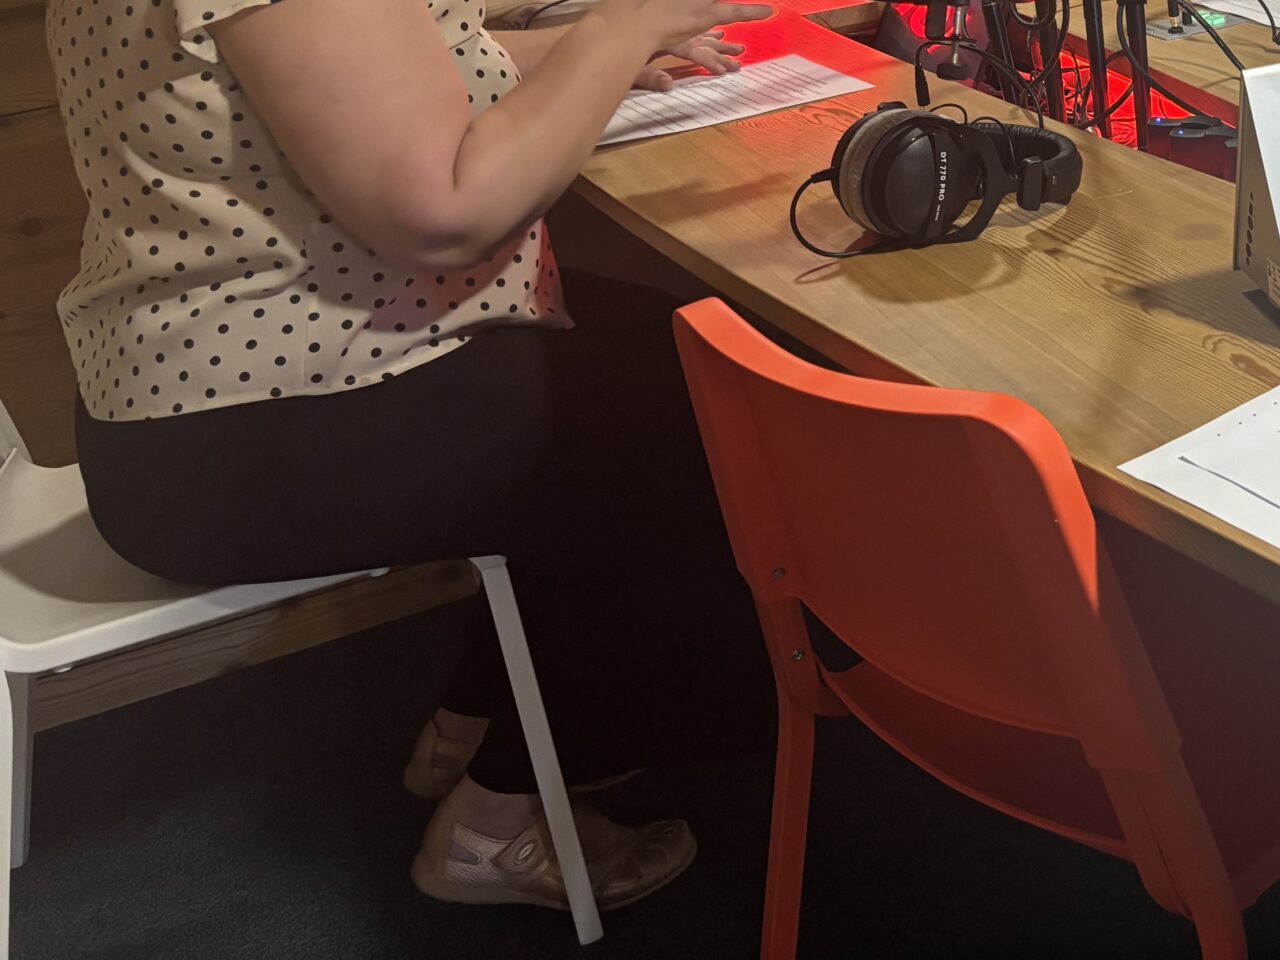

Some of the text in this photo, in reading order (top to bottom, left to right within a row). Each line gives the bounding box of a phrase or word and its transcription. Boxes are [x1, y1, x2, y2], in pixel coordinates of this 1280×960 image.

[940, 151, 947, 163] DT
[939, 165, 947, 181] 770
[938, 183, 946, 201] PRO
